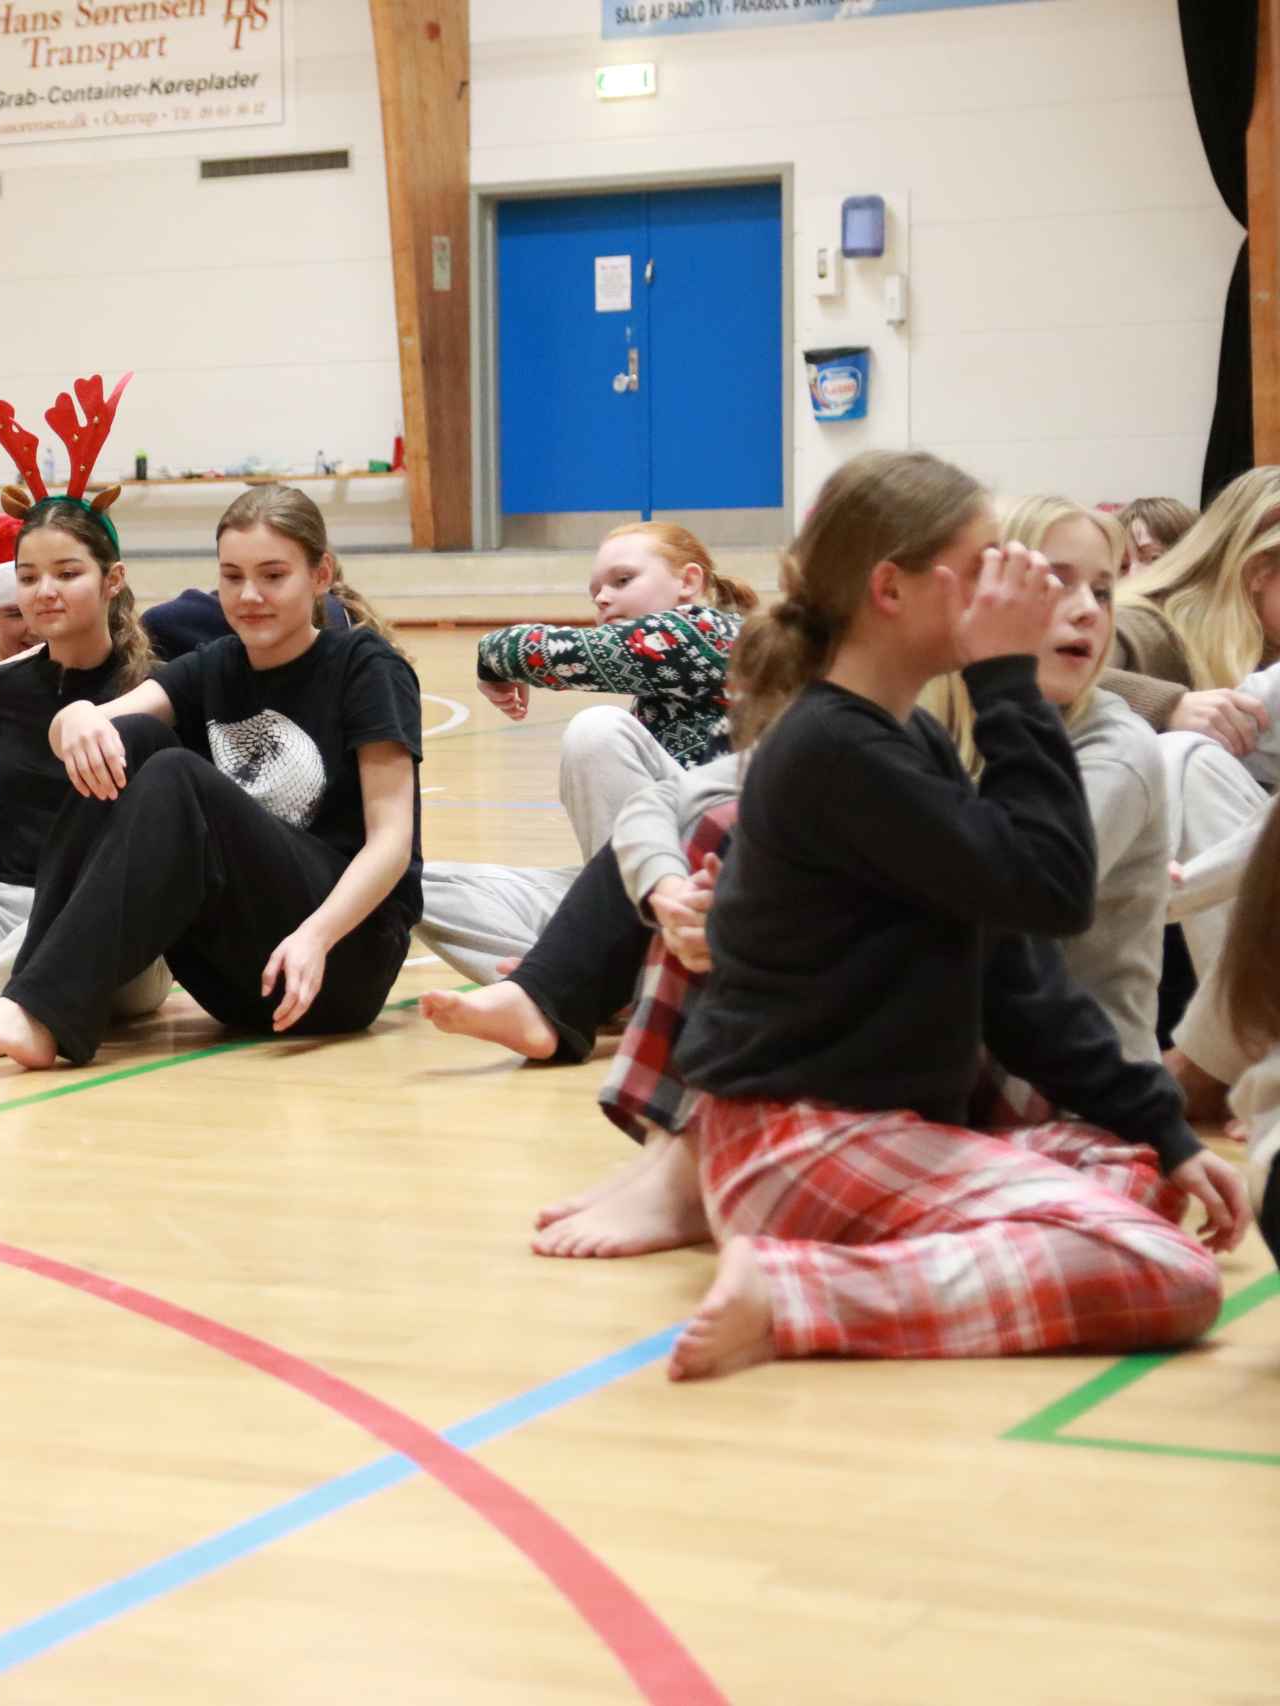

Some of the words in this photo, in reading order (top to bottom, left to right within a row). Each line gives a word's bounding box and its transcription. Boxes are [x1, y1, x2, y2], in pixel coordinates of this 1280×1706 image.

[74, 0, 207, 28] Sørensen
[615, 5, 646, 25] SALG
[650, 3, 665, 20] AF
[667, 0, 705, 19] RADIO
[708, 0, 722, 16] TV
[24, 32, 167, 71] Transport
